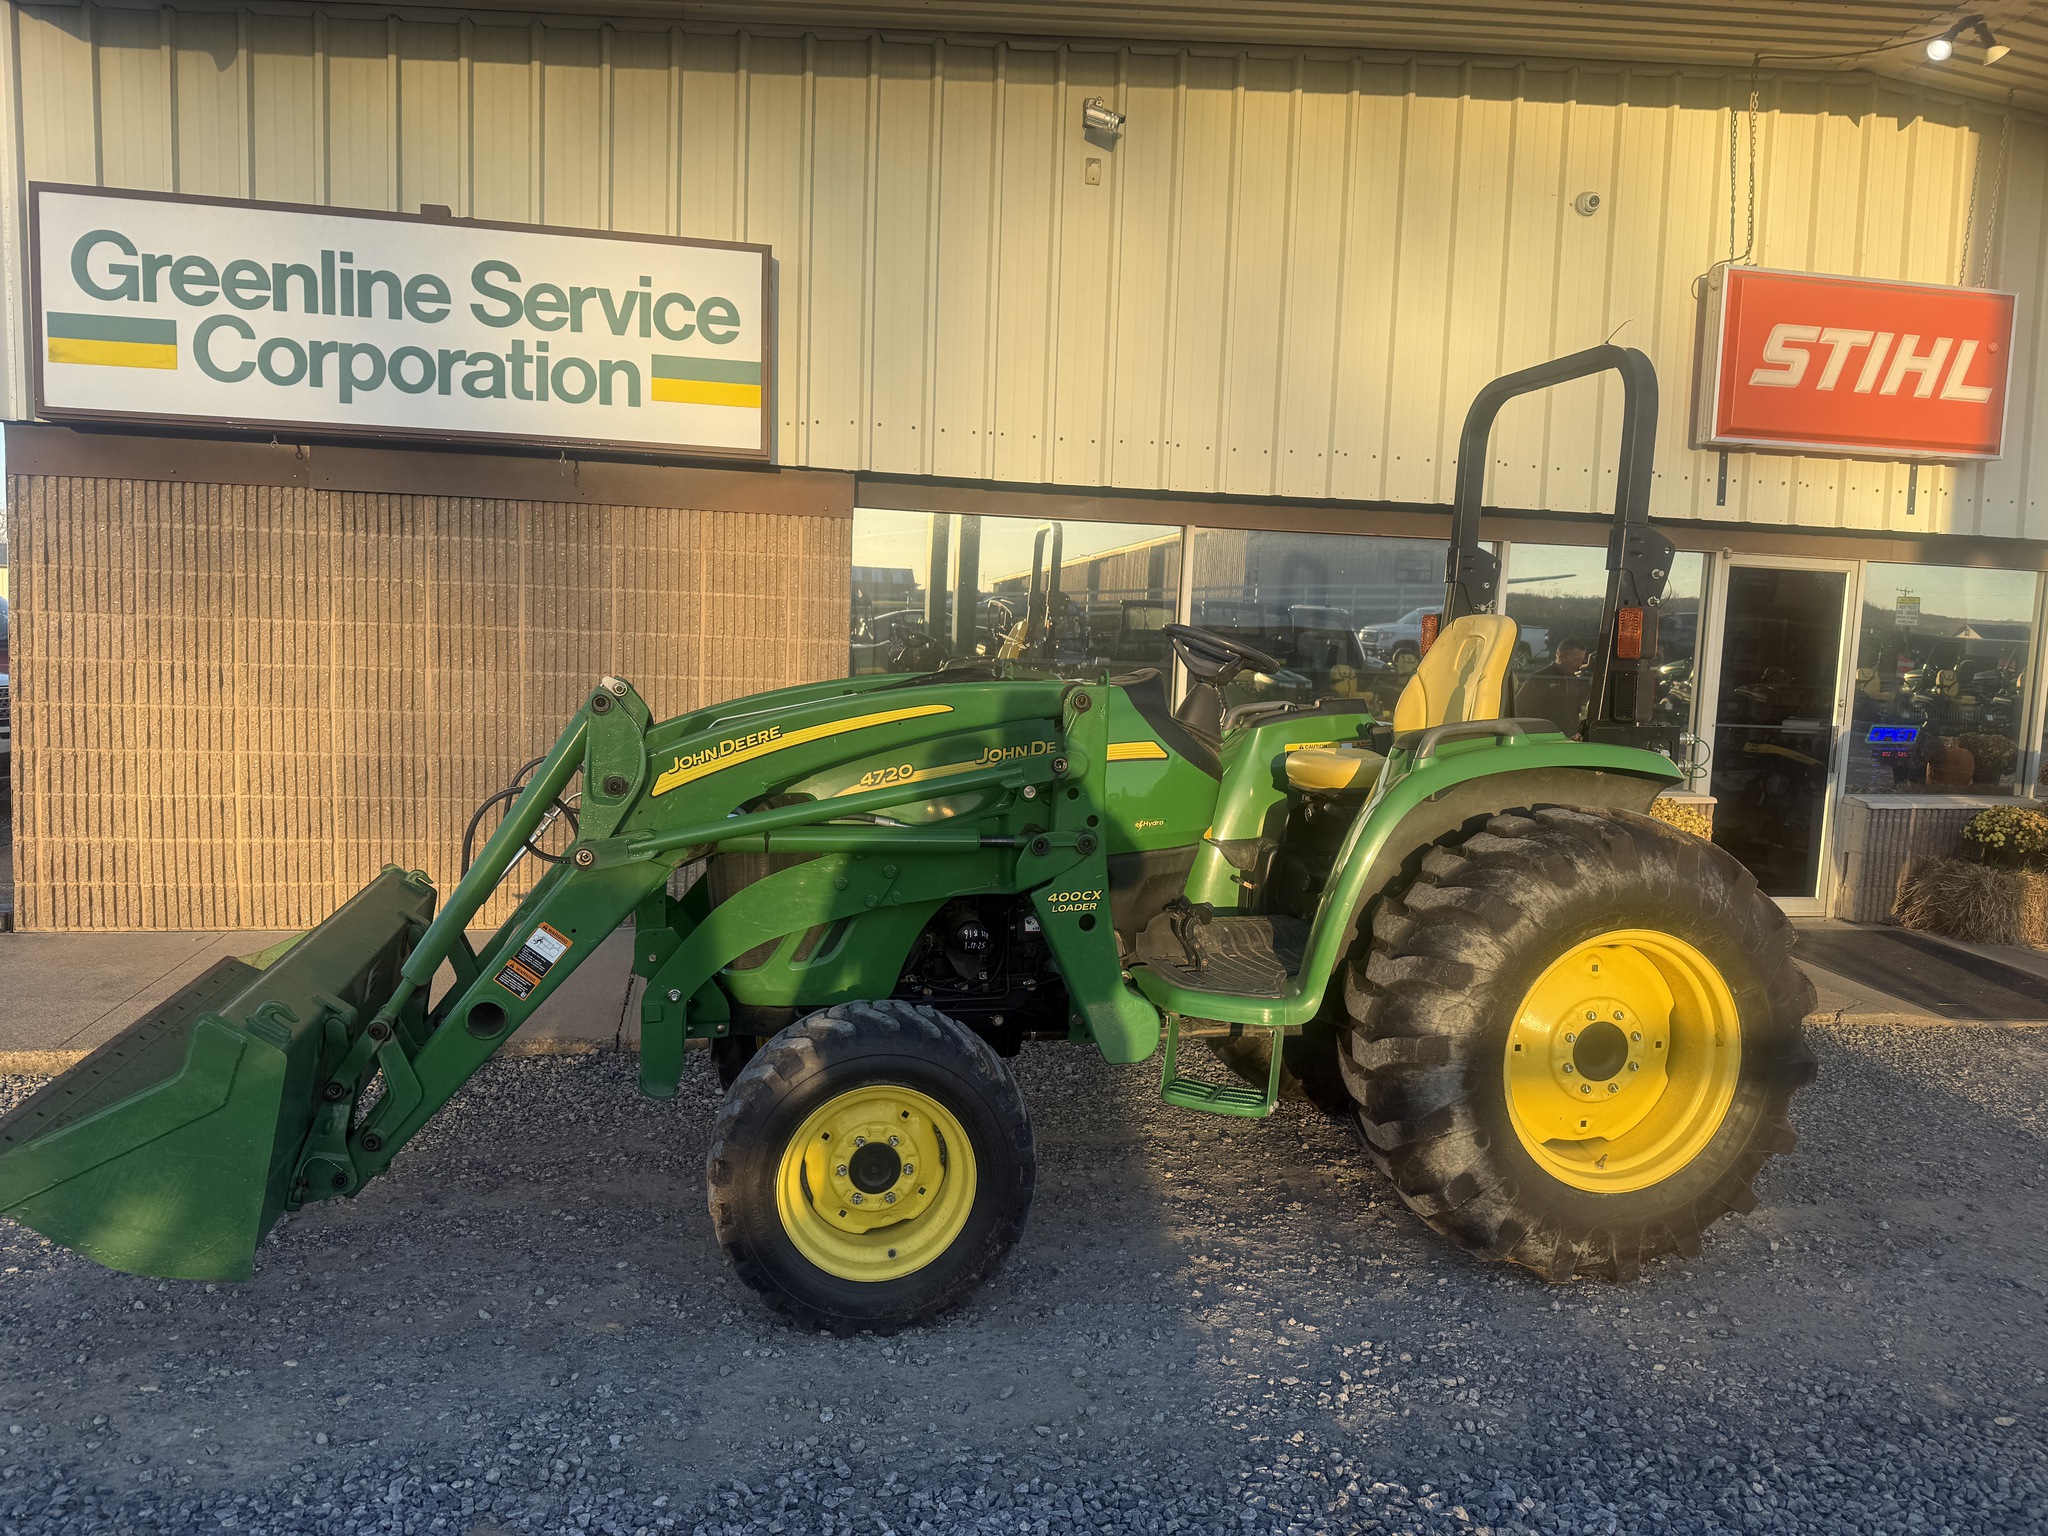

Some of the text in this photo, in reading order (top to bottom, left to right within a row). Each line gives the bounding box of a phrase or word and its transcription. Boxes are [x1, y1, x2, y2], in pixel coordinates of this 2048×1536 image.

[70, 229, 742, 345] Greenline Service
[192, 313, 643, 407] Corporation
[1748, 323, 1993, 403] STIHL
[1869, 727, 1918, 742] OPEN
[668, 725, 782, 774] JOHN DEERE
[975, 745, 1028, 764] JOHN
[860, 764, 914, 786] 4720
[1047, 889, 1103, 903] 400CX
[1051, 902, 1097, 913] LOADER
[548, 928, 569, 945] WARNING
[515, 967, 537, 983] WARNING
